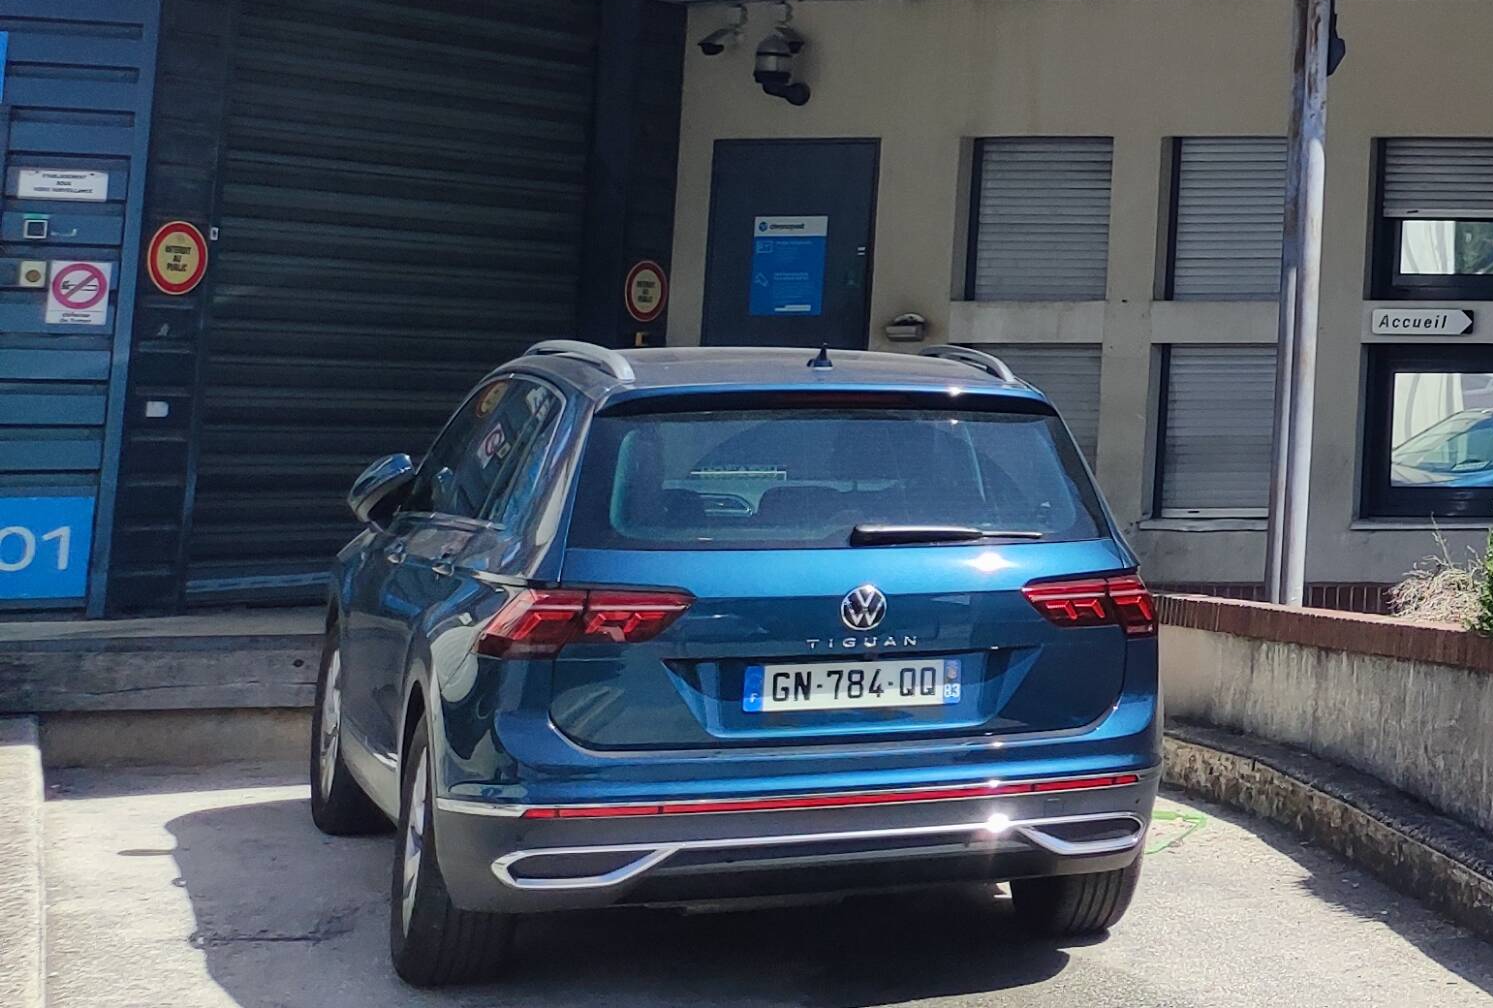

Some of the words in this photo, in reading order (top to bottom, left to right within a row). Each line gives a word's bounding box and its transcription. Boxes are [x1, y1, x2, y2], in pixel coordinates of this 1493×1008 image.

[166, 262, 188, 272] PUBLIC
[1378, 314, 1448, 329] Accueil
[806, 635, 918, 649] TIGUAN
[772, 666, 937, 702] GN-784-QQ
[944, 683, 961, 698] 83
